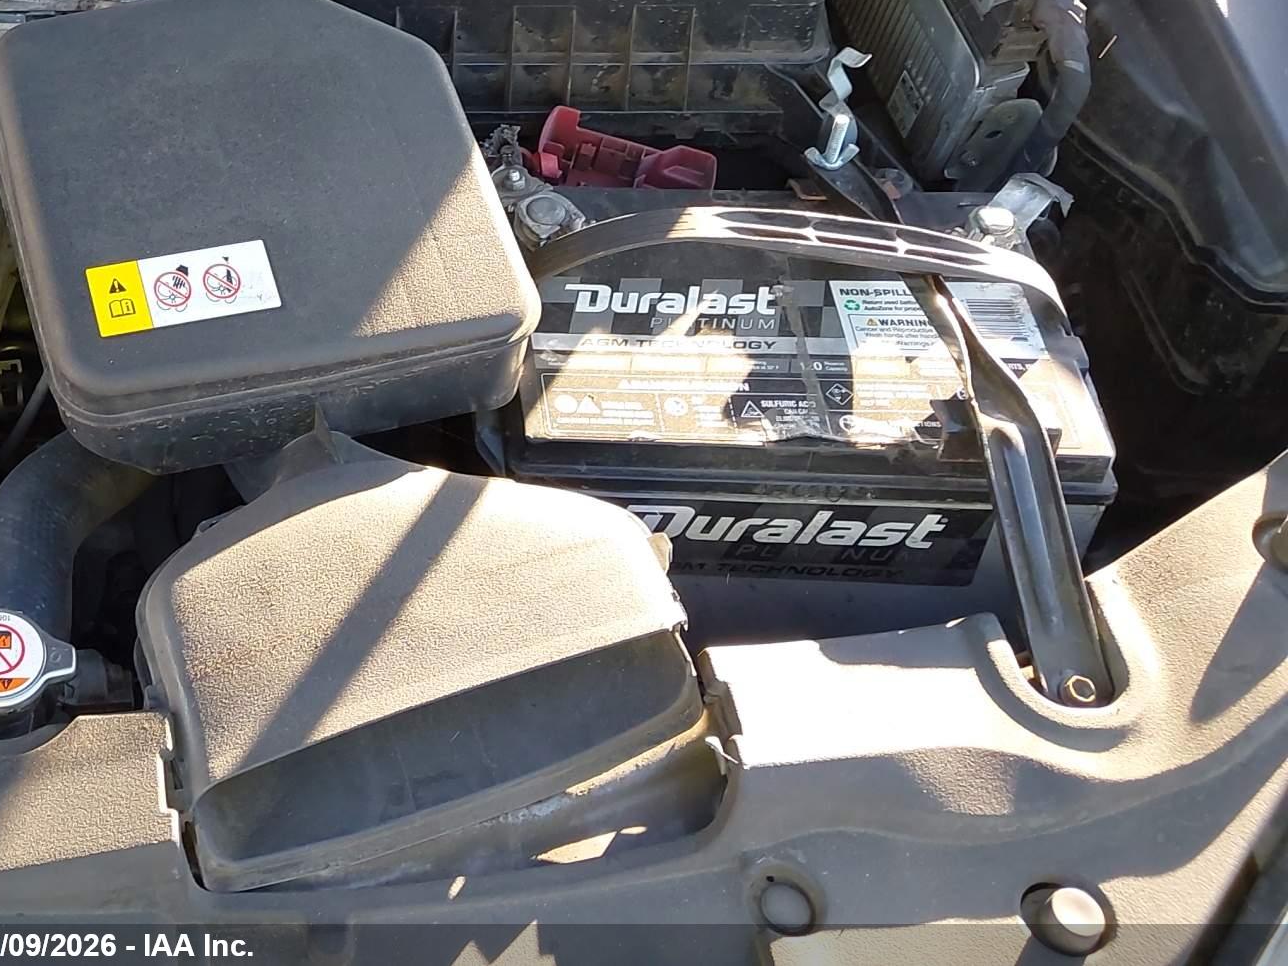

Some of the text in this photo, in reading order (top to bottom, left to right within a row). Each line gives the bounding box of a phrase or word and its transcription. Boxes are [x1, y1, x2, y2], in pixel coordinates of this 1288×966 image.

[840, 288, 912, 297] NON-SPILL
[564, 283, 778, 316] Duralast
[878, 318, 929, 327] WARNIN
[580, 337, 627, 348] AGM
[798, 400, 817, 408] ACD
[626, 504, 947, 550] Duralast
